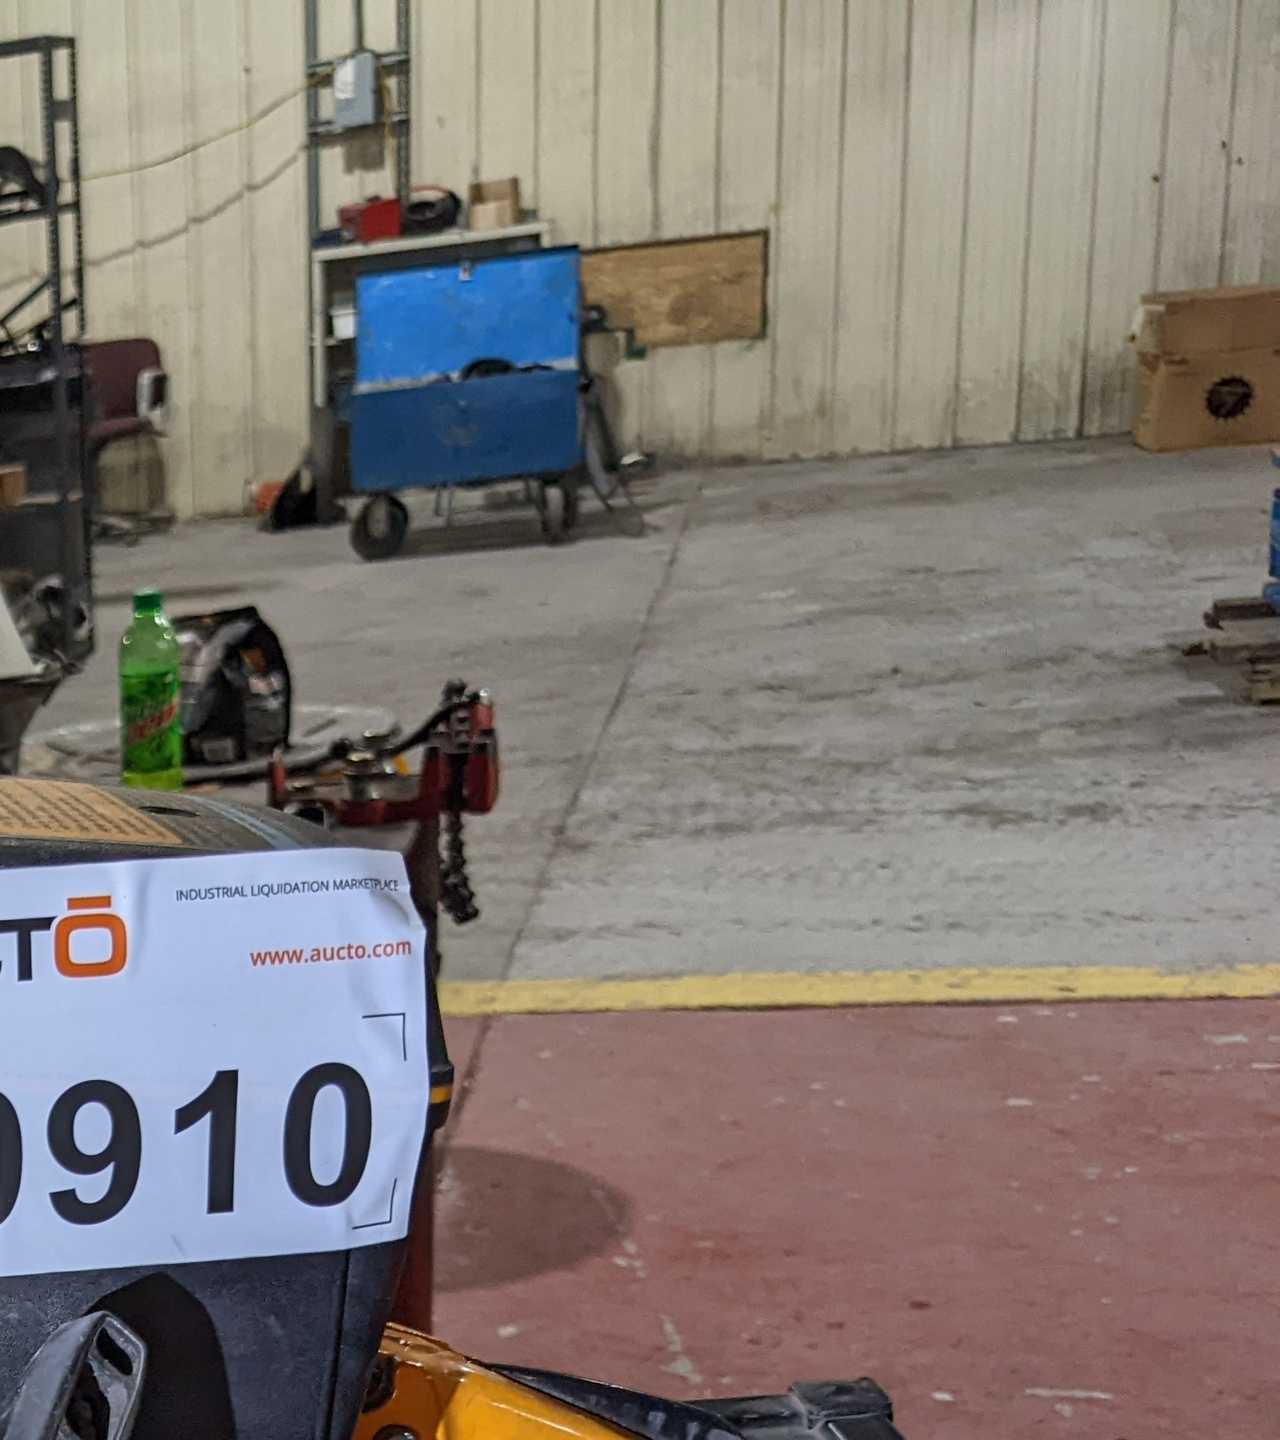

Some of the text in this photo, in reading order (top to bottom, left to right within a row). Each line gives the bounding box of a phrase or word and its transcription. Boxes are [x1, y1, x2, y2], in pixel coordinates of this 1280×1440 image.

[175, 877, 399, 901] INDUSTRIAL LIQUIDATION MARKETPLACE
[249, 939, 412, 968] www.aucto.com
